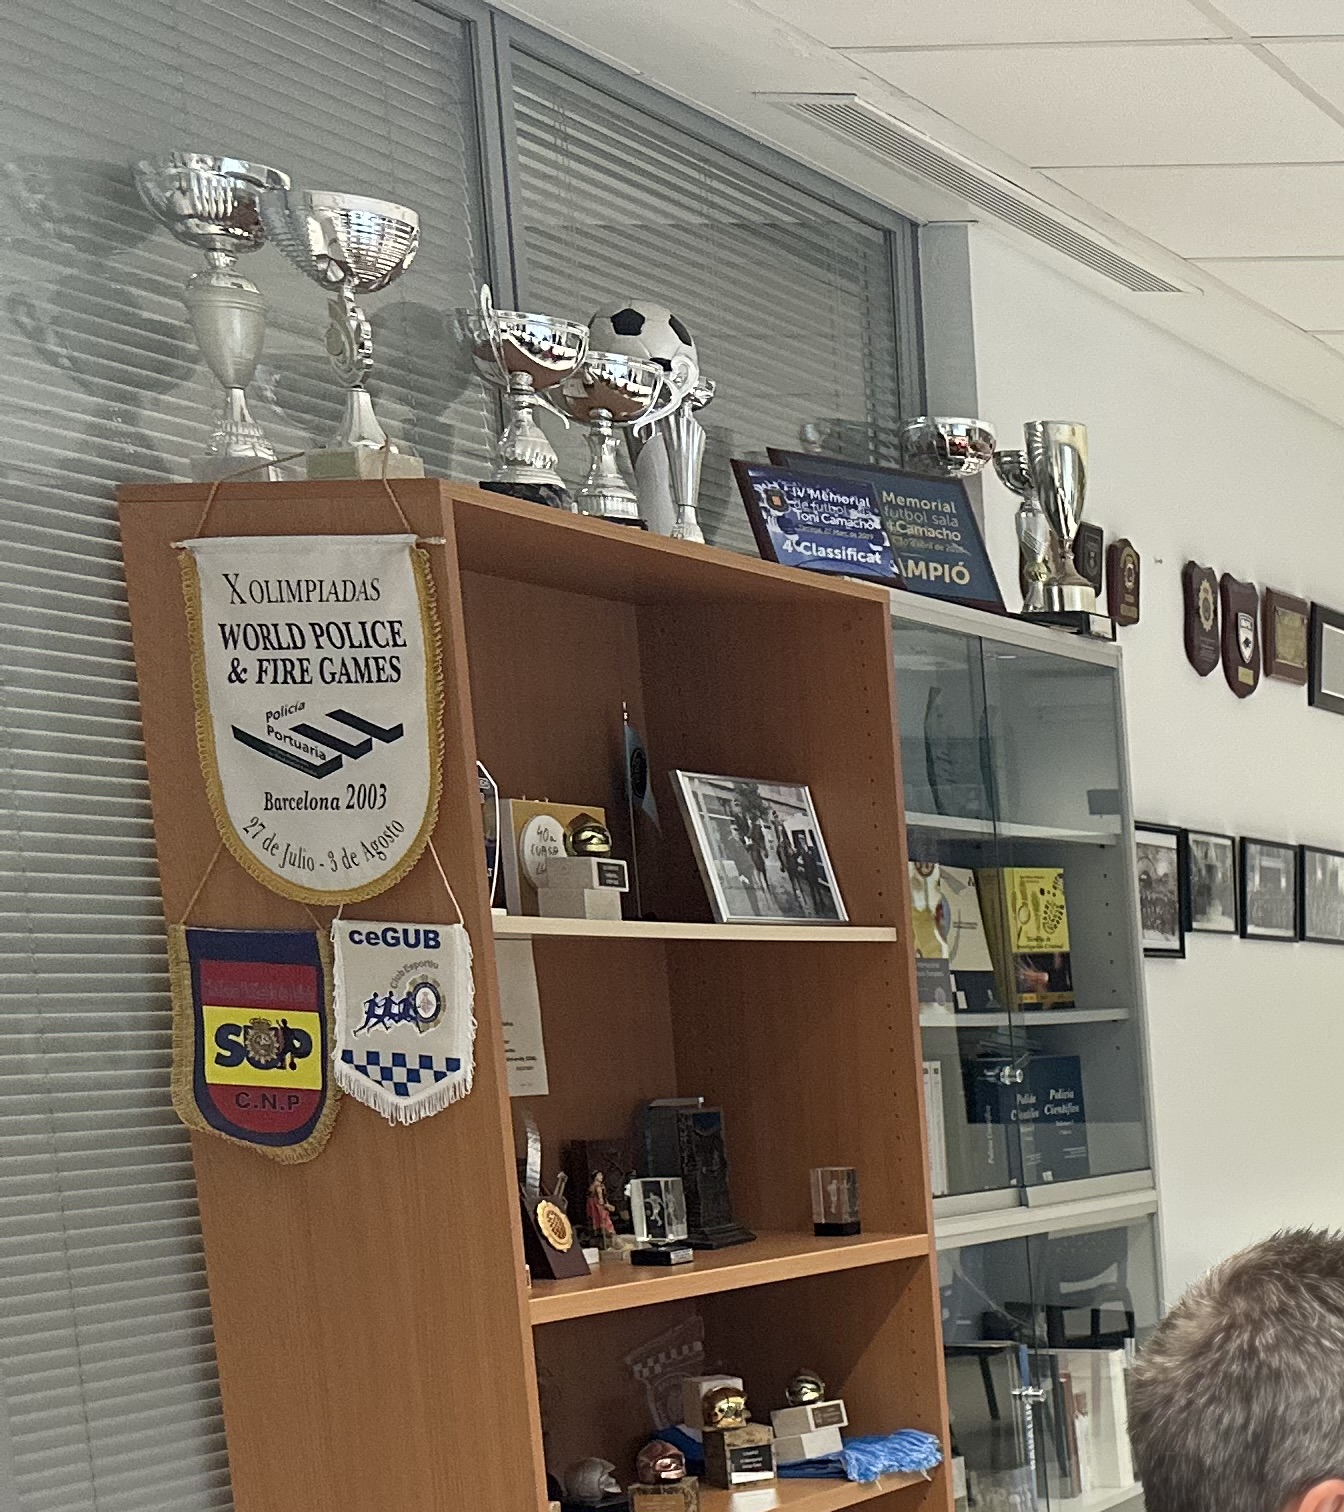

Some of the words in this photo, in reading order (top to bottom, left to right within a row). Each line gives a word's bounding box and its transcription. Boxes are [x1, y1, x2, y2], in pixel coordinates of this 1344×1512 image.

[810, 488, 871, 508] Memorial
[881, 490, 957, 514] Memorial
[821, 513, 875, 531] Camacho
[884, 505, 928, 523] futbol
[931, 514, 959, 528] sala
[896, 520, 962, 541] Camacho
[799, 541, 882, 565] Classificat
[222, 573, 247, 605] X
[249, 577, 381, 605] OLIMPIADAS
[218, 622, 306, 651] WORLD
[308, 619, 408, 650] POLICE
[227, 656, 249, 684] &
[255, 657, 314, 685] FIRE
[319, 655, 402, 685] GAMES
[265, 700, 306, 724] Policía
[267, 724, 327, 761] Portuaria
[264, 790, 341, 811] Barcelona
[345, 783, 388, 810] 2003
[242, 816, 267, 840] 27
[262, 832, 280, 857] de
[278, 842, 316, 872] Julio
[327, 850, 339, 873] 3
[341, 846, 361, 870] de
[359, 819, 405, 862] Agosto
[348, 926, 441, 949] ceGUB
[389, 969, 406, 990] Club
